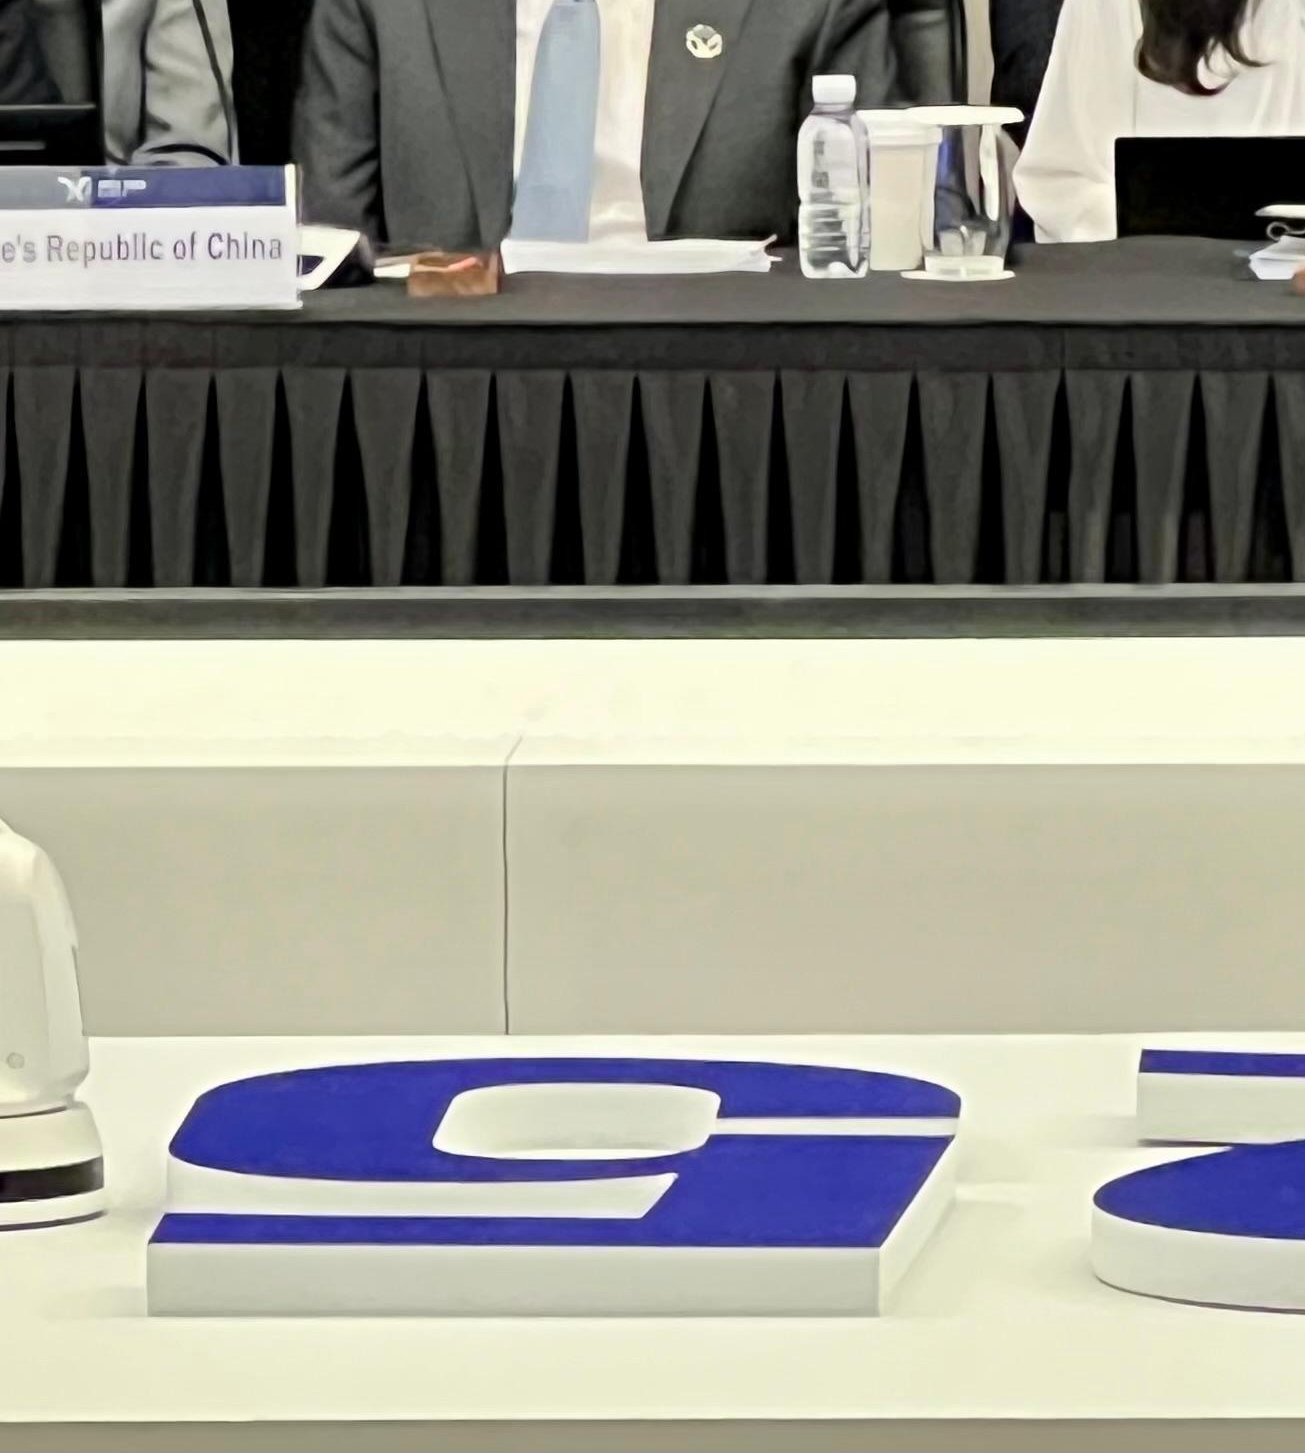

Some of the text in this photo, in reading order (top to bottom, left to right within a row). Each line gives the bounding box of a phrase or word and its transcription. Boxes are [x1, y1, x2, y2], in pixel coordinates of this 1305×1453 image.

[46, 232, 163, 269] Republic
[172, 230, 197, 261] of
[207, 230, 283, 261] China
